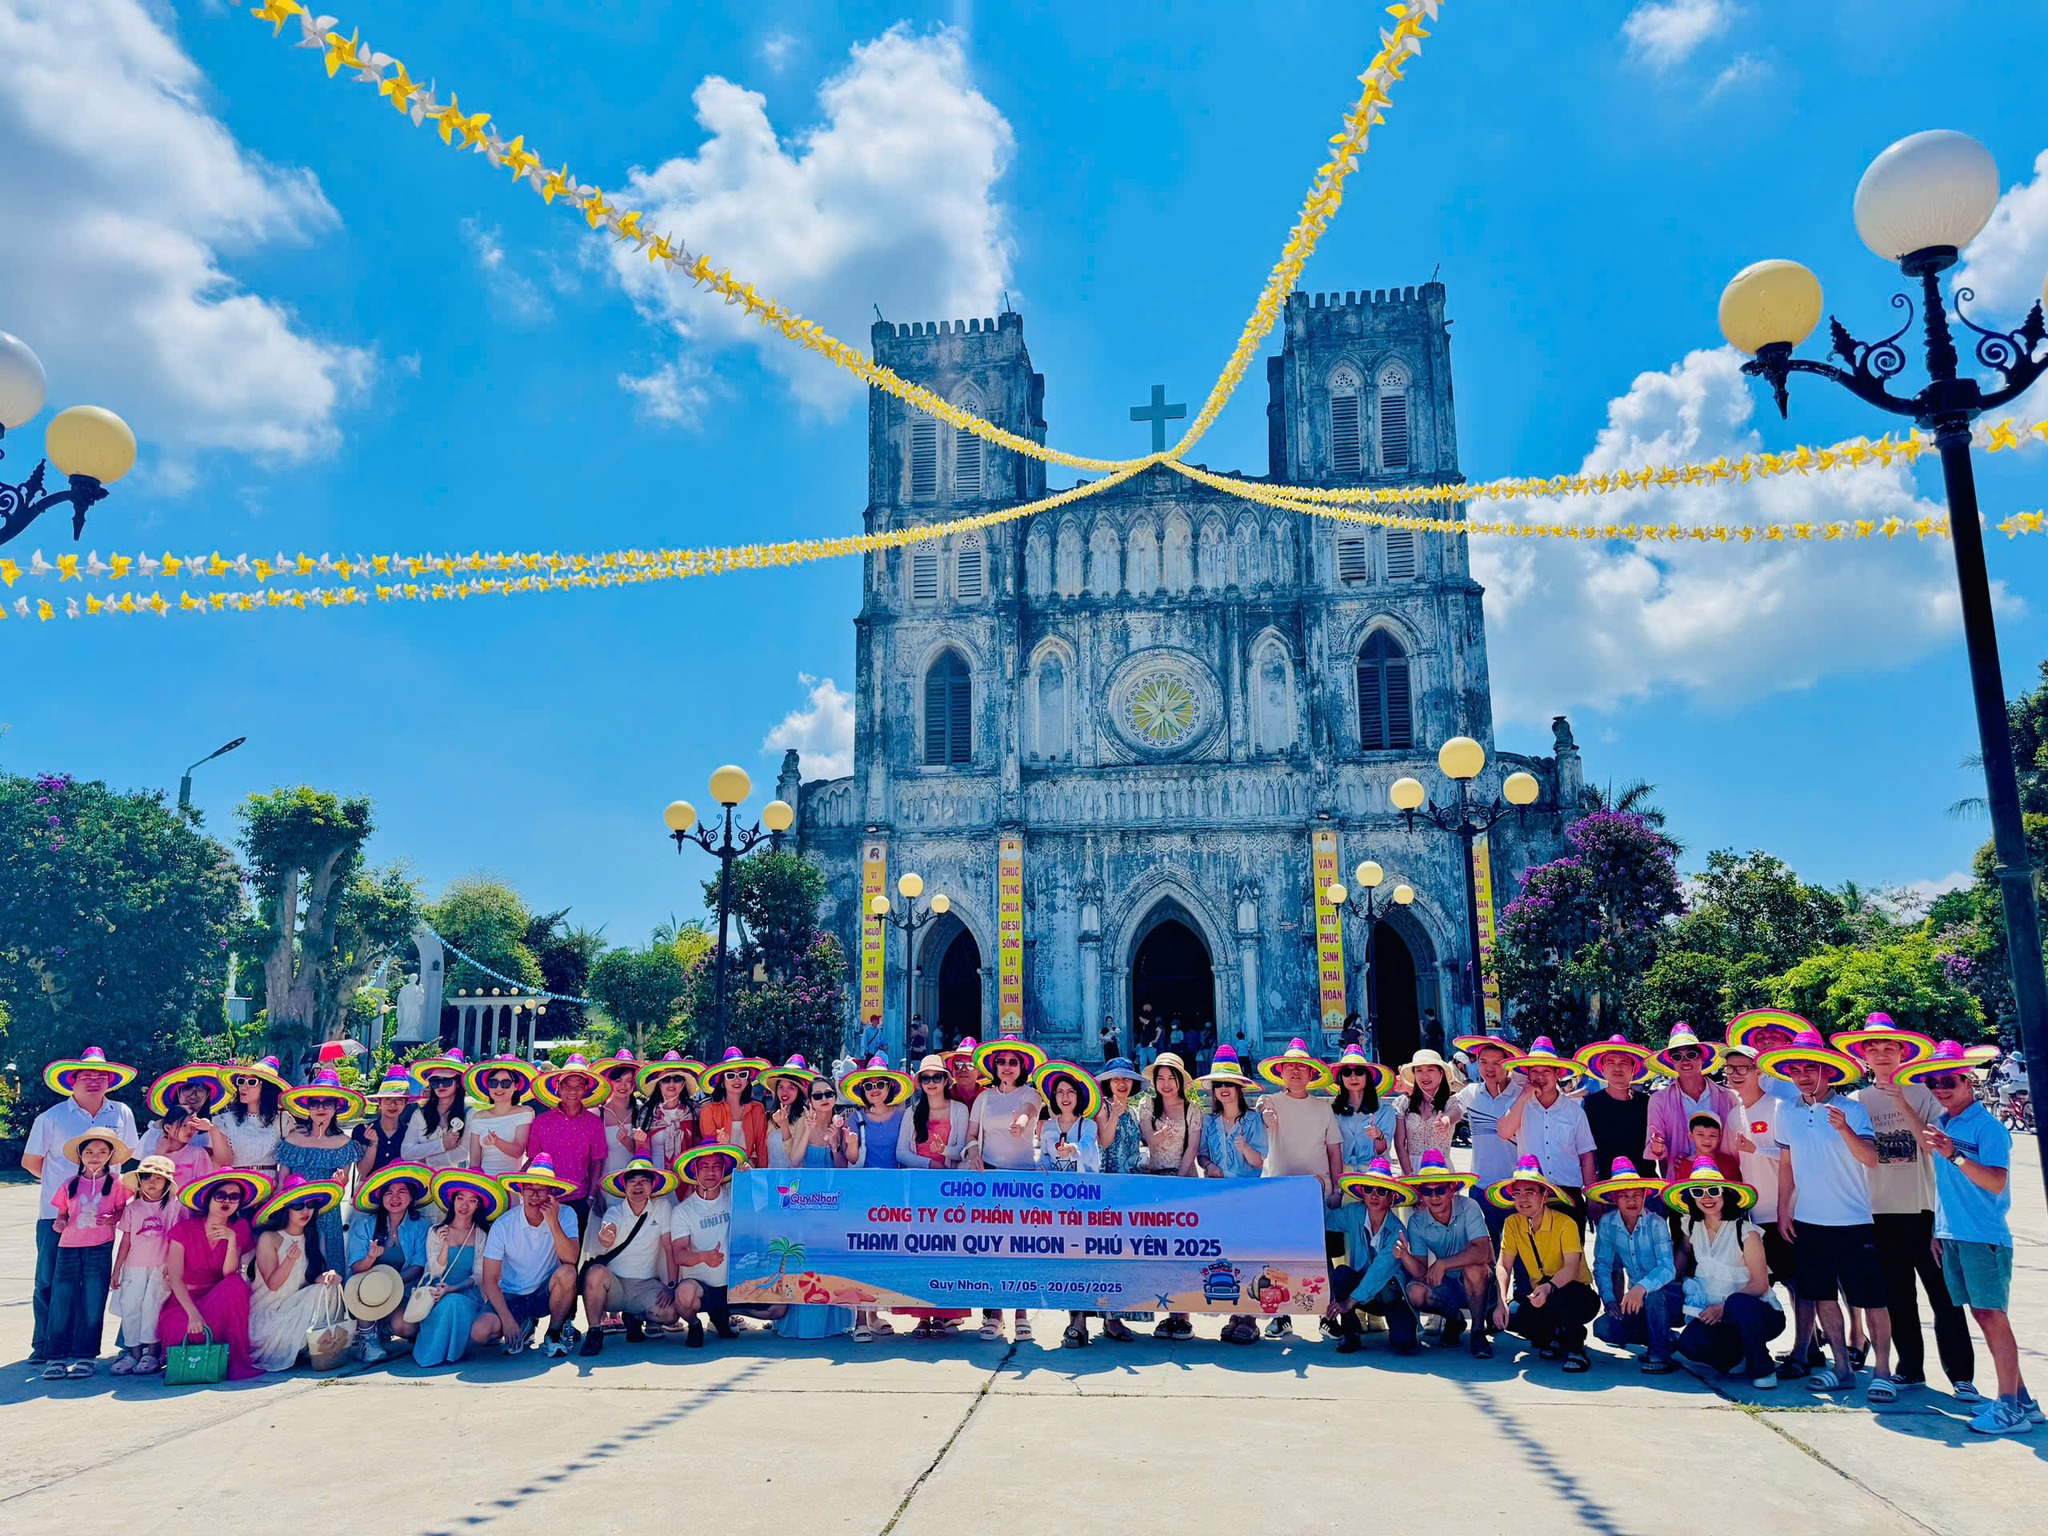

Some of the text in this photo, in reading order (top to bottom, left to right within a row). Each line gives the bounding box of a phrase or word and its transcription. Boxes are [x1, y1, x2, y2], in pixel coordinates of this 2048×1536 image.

[1319, 859, 1332, 871] VẠN
[1002, 885, 1019, 896] TỤNG
[1002, 934, 1019, 948] SỐNG
[1320, 933, 1338, 945] PHỤC
[1005, 956, 1016, 968] LẠI
[1322, 951, 1338, 962] SINH
[1004, 993, 1018, 1003] VINH
[940, 1178, 986, 1197] CHÀO
[1050, 1181, 1101, 1200] ĐOÀN
[868, 1203, 1199, 1228] CÔNG TY CỔ PHẦN VẬN TẢI BIỂN VINAFCO
[847, 1233, 898, 1251] THAM
[904, 1234, 956, 1253] QUAN
[962, 1235, 1004, 1254] QUY
[1010, 1236, 1064, 1253] NHƠN
[1085, 1234, 1122, 1255] PHÚ
[1130, 1235, 1167, 1256] YÊN
[1174, 1238, 1222, 1257] 2025
[930, 1280, 954, 1292] Quy
[957, 1279, 993, 1293] Nhơn,
[1000, 1280, 1037, 1293] 17/05
[1047, 1281, 1122, 1294] 20/05/2025
